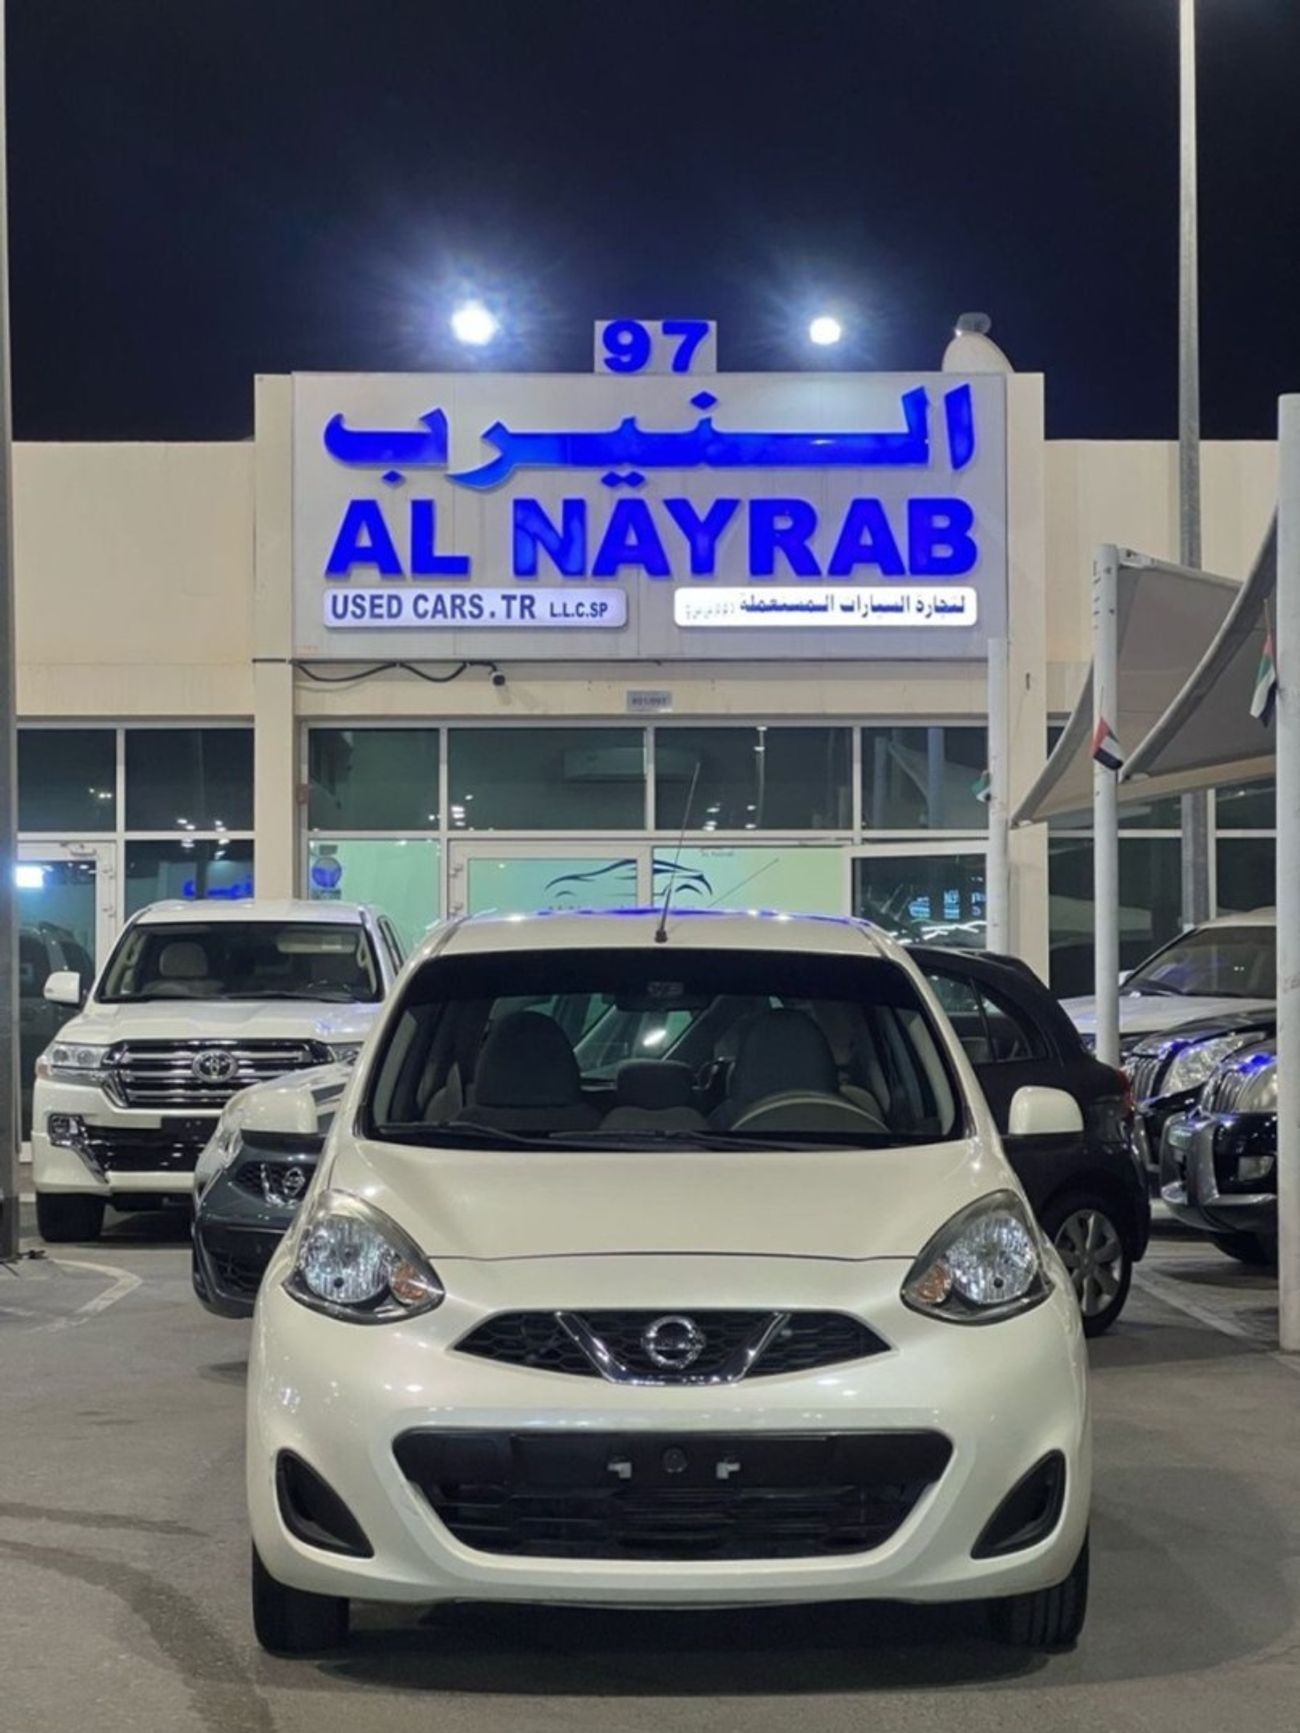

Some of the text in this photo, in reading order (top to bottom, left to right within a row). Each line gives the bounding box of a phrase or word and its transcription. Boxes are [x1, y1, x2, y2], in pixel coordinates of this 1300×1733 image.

[602, 319, 710, 374] 97
[324, 383, 975, 489] النيرب
[325, 498, 978, 578] AL NAYRAB
[331, 594, 403, 620] USED
